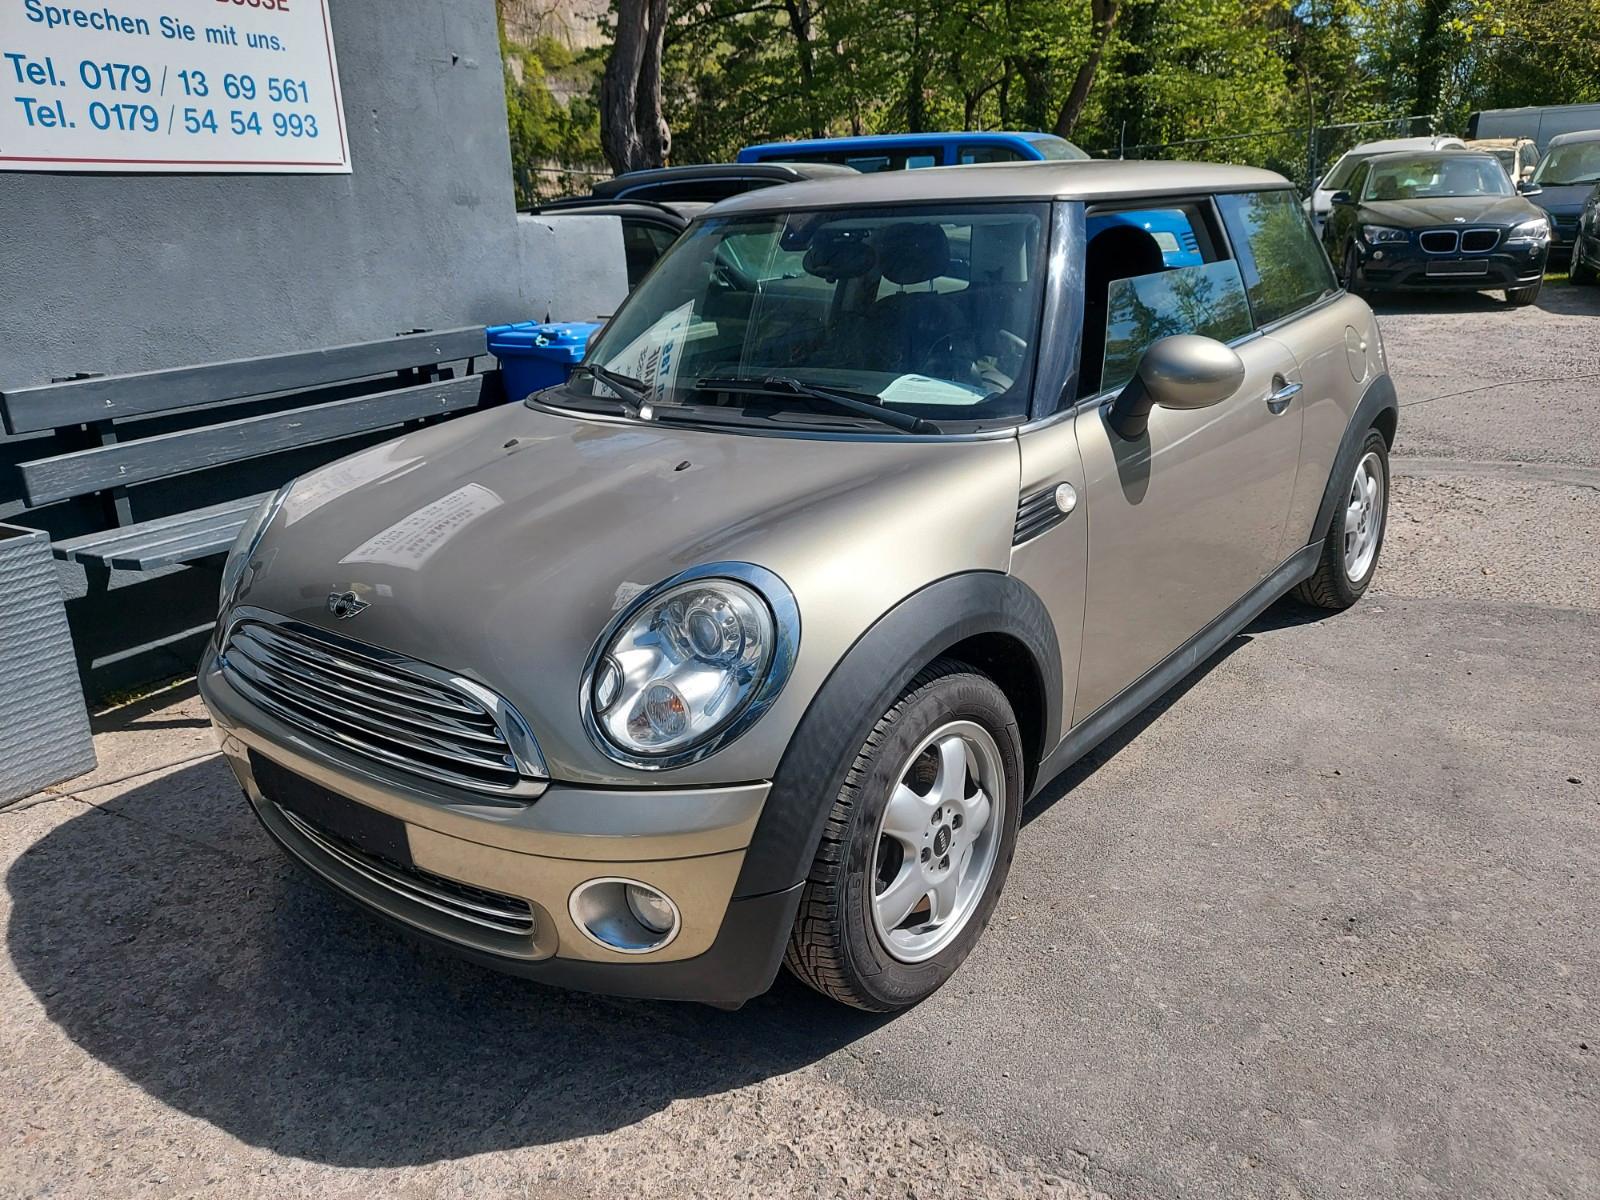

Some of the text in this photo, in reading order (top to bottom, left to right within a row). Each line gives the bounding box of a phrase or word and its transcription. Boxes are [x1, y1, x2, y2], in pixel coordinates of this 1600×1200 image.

[24, 0, 286, 51] Sprechen Sie mit uns.
[4, 53, 65, 87] Tel.
[80, 60, 151, 93] 0179
[178, 70, 208, 97] 13
[224, 74, 256, 100] 69
[269, 78, 308, 103] 561
[15, 97, 75, 128] Tel.
[89, 102, 159, 132] 0179
[185, 108, 218, 134] 54
[231, 111, 262, 135] 54
[273, 113, 318, 138] 993
